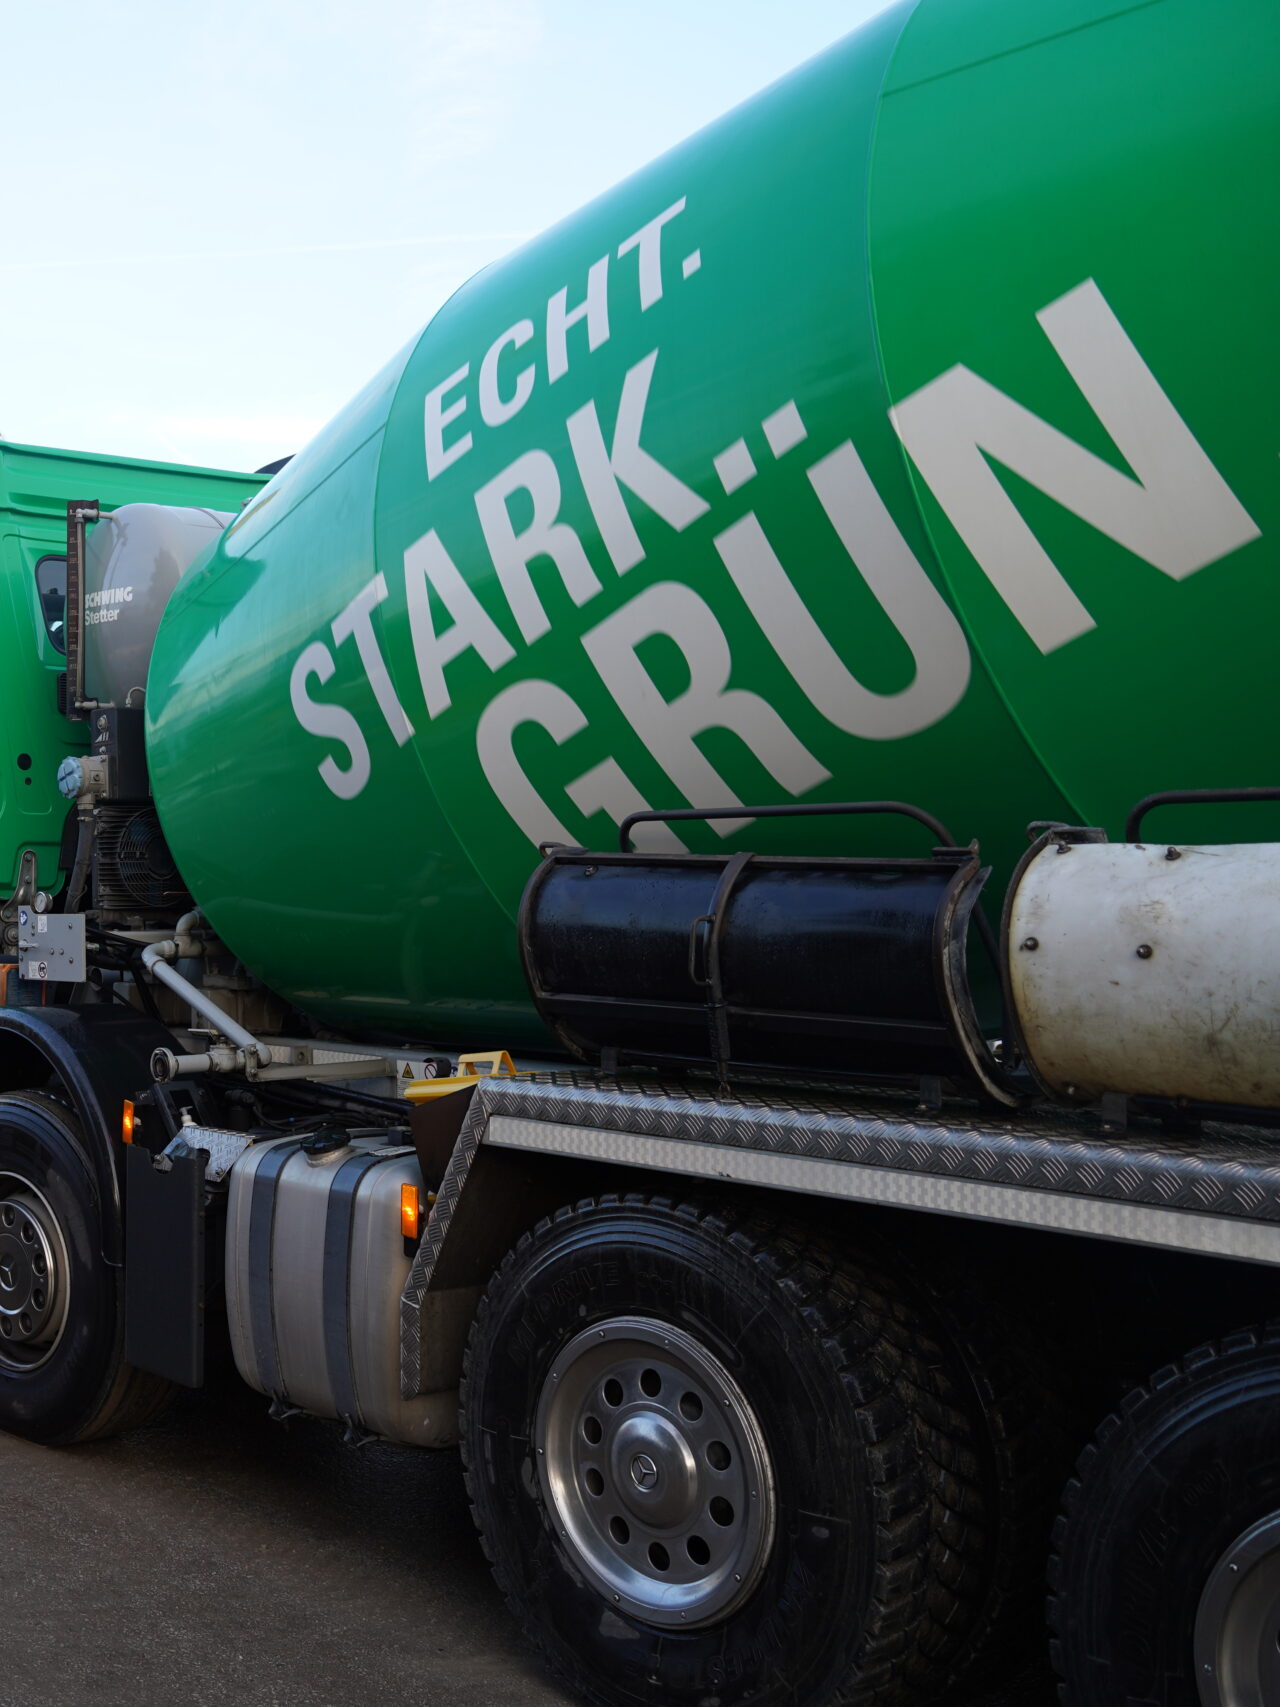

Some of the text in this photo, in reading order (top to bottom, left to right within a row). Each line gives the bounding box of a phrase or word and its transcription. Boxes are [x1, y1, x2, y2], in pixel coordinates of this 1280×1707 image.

[423, 197, 702, 482] ECHT.
[85, 586, 133, 608] SCHWING
[85, 608, 120, 626] Stetter
[289, 348, 711, 801] STARK
[475, 276, 1262, 856] GRÜN
